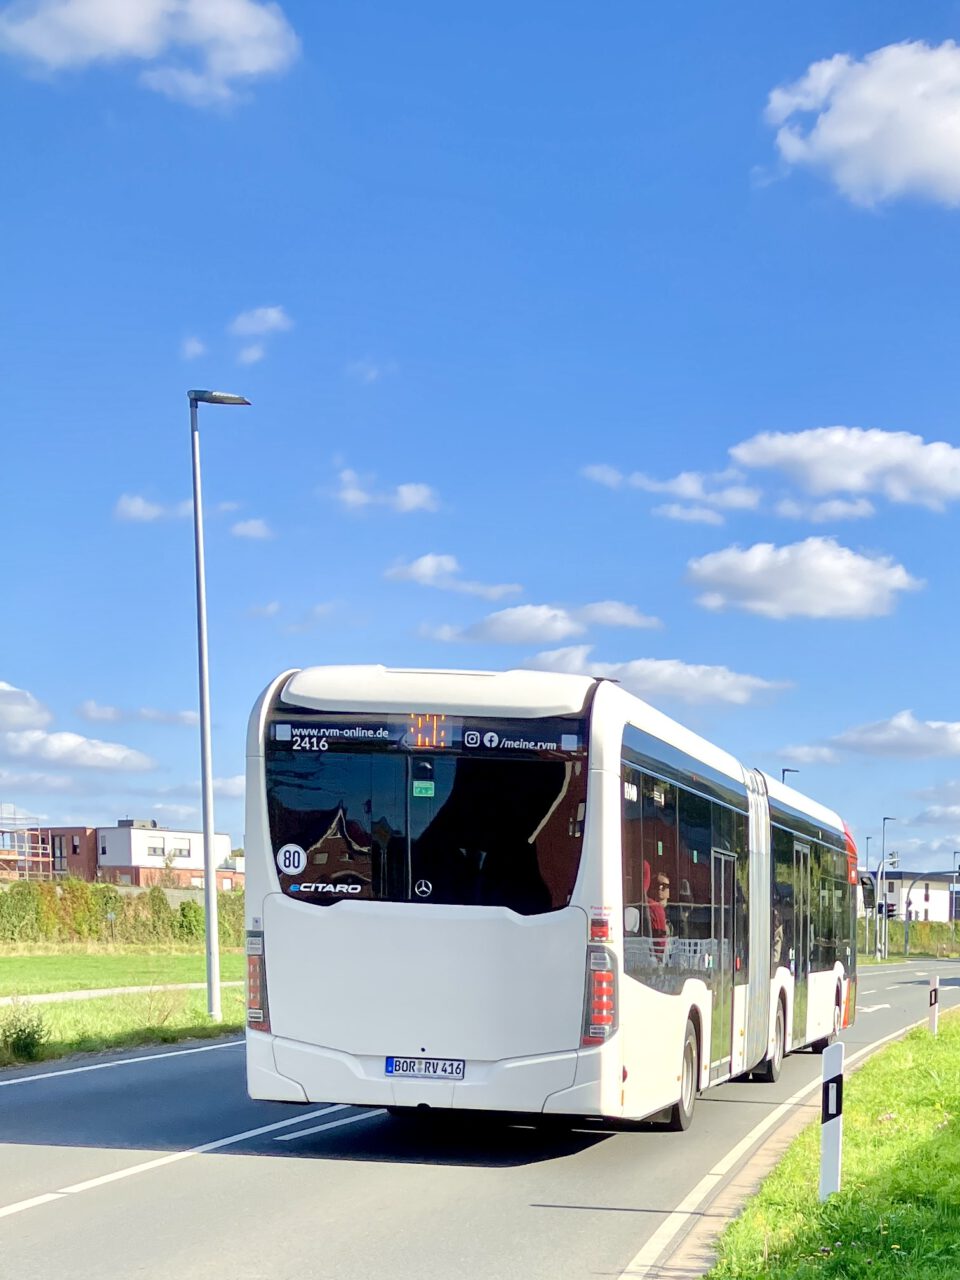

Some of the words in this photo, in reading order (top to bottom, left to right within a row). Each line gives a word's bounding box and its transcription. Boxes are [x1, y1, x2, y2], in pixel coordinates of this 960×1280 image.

[292, 727, 389, 738] www.rvm-online.de
[292, 736, 329, 750] 2416
[500, 737, 557, 750] /meine.rvm
[284, 850, 301, 869] 80
[289, 882, 362, 893] eCITARO
[394, 1059, 416, 1073] BOR
[424, 1061, 439, 1074] RV
[441, 1062, 462, 1075] 416
